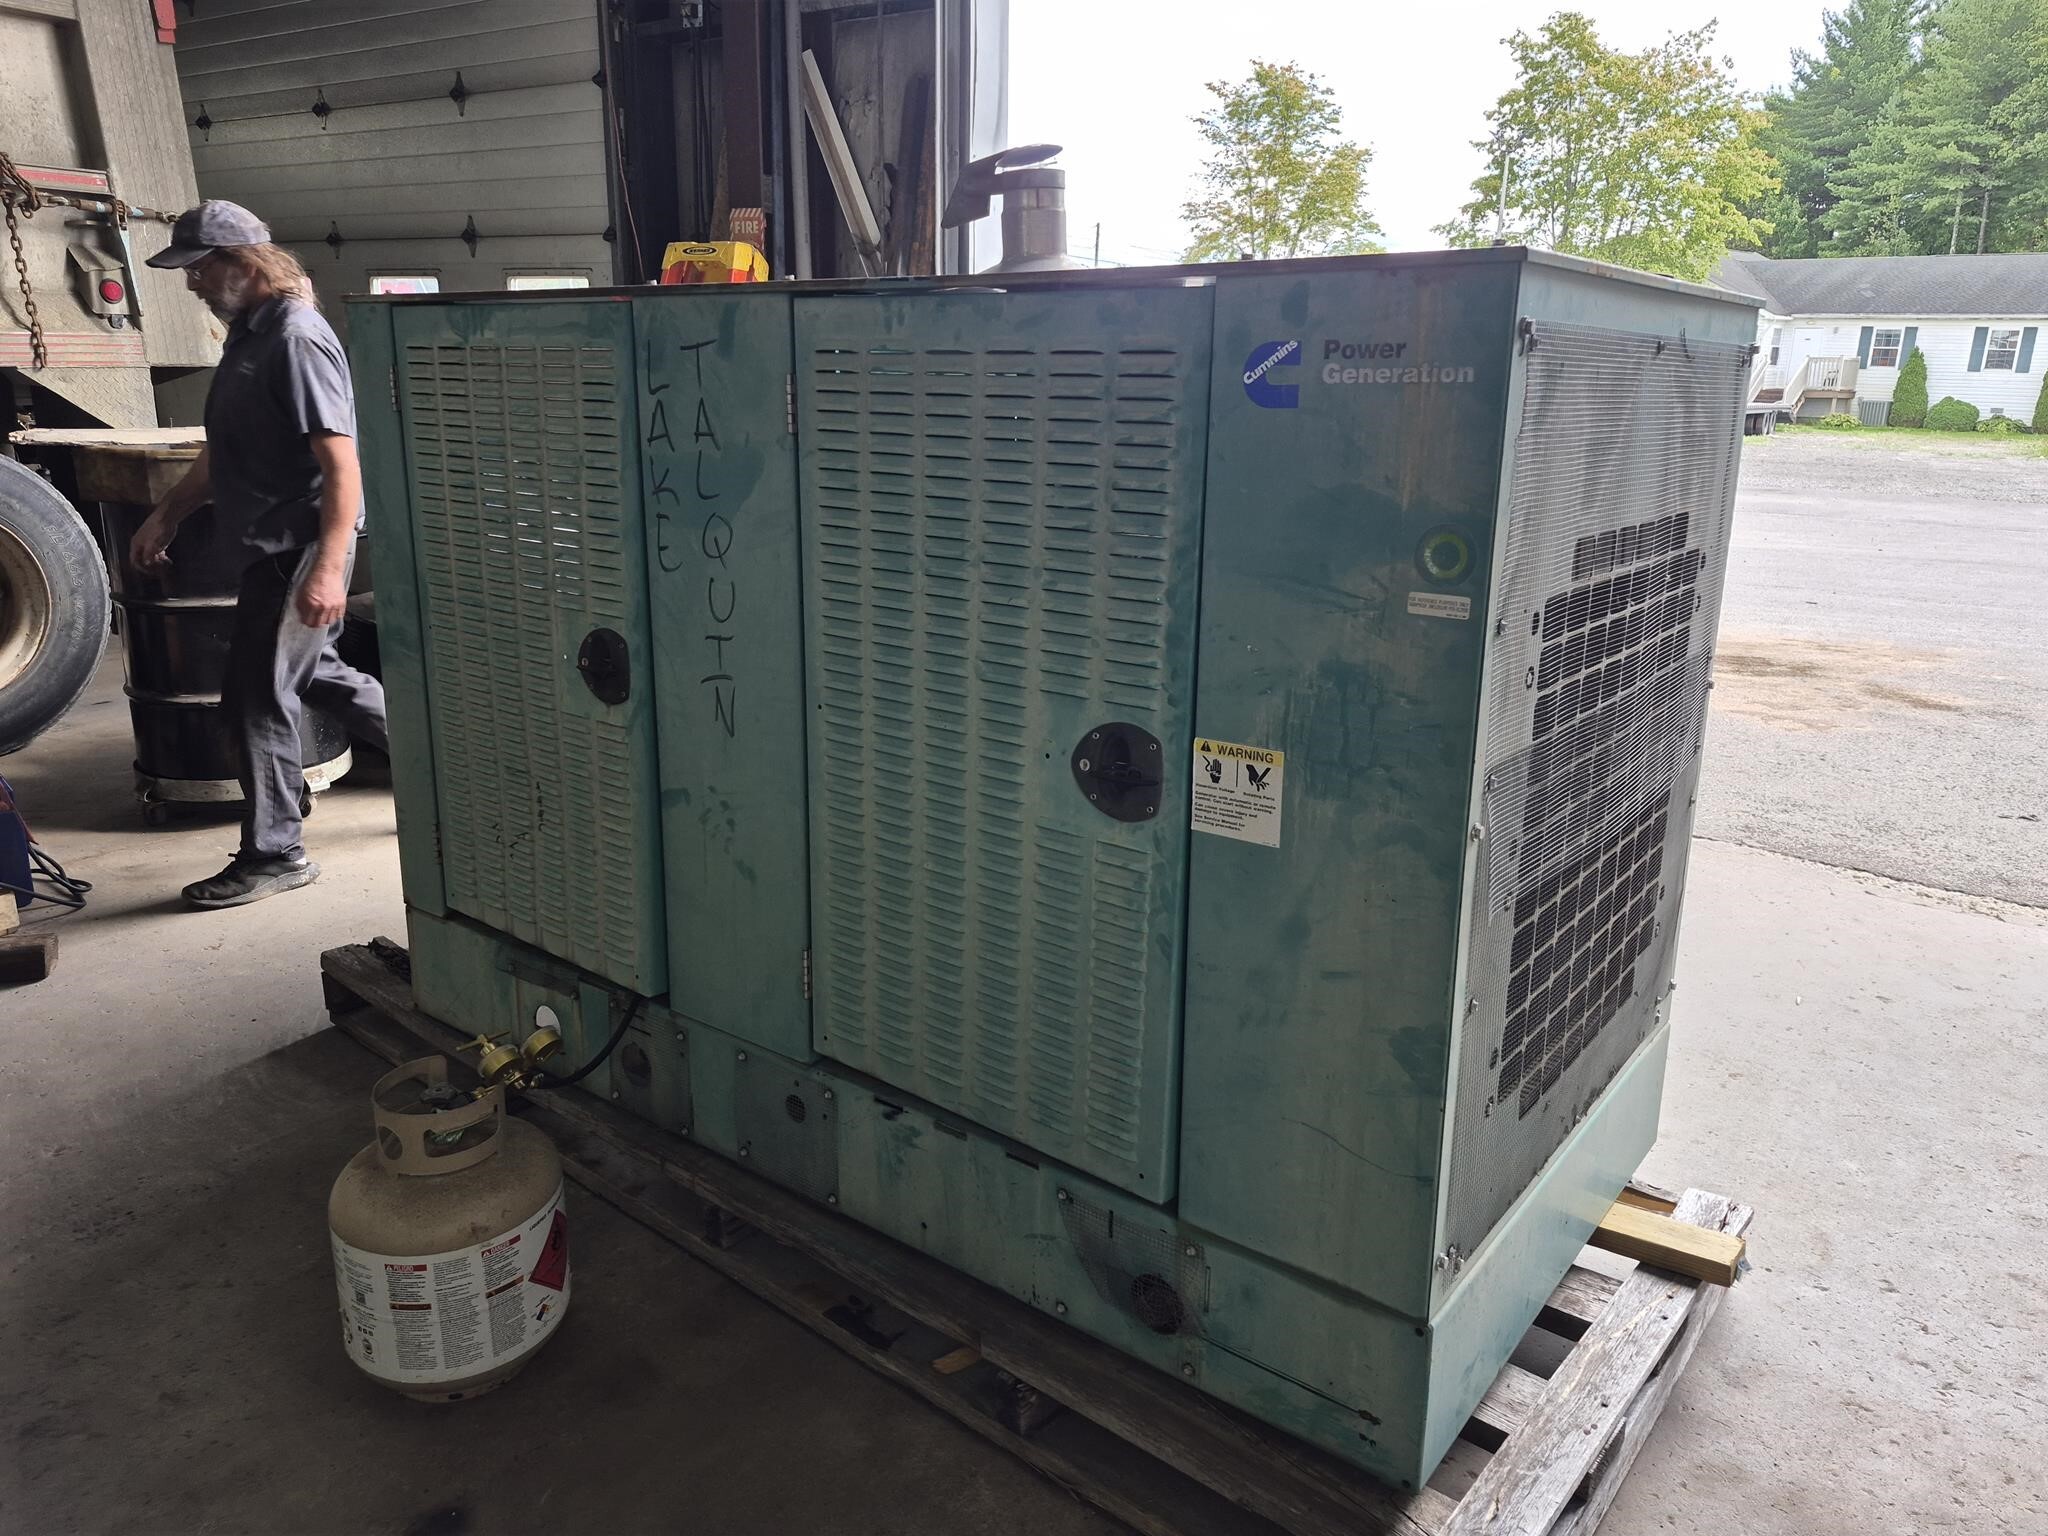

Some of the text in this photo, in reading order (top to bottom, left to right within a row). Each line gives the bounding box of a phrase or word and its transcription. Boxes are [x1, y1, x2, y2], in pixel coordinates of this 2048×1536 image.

[734, 220, 759, 234] FIRE
[1323, 339, 1407, 360] Power
[1243, 338, 1298, 385] Cummins
[1322, 362, 1474, 385] Generation
[646, 338, 682, 572] LAKE
[1216, 743, 1274, 764] WARNING
